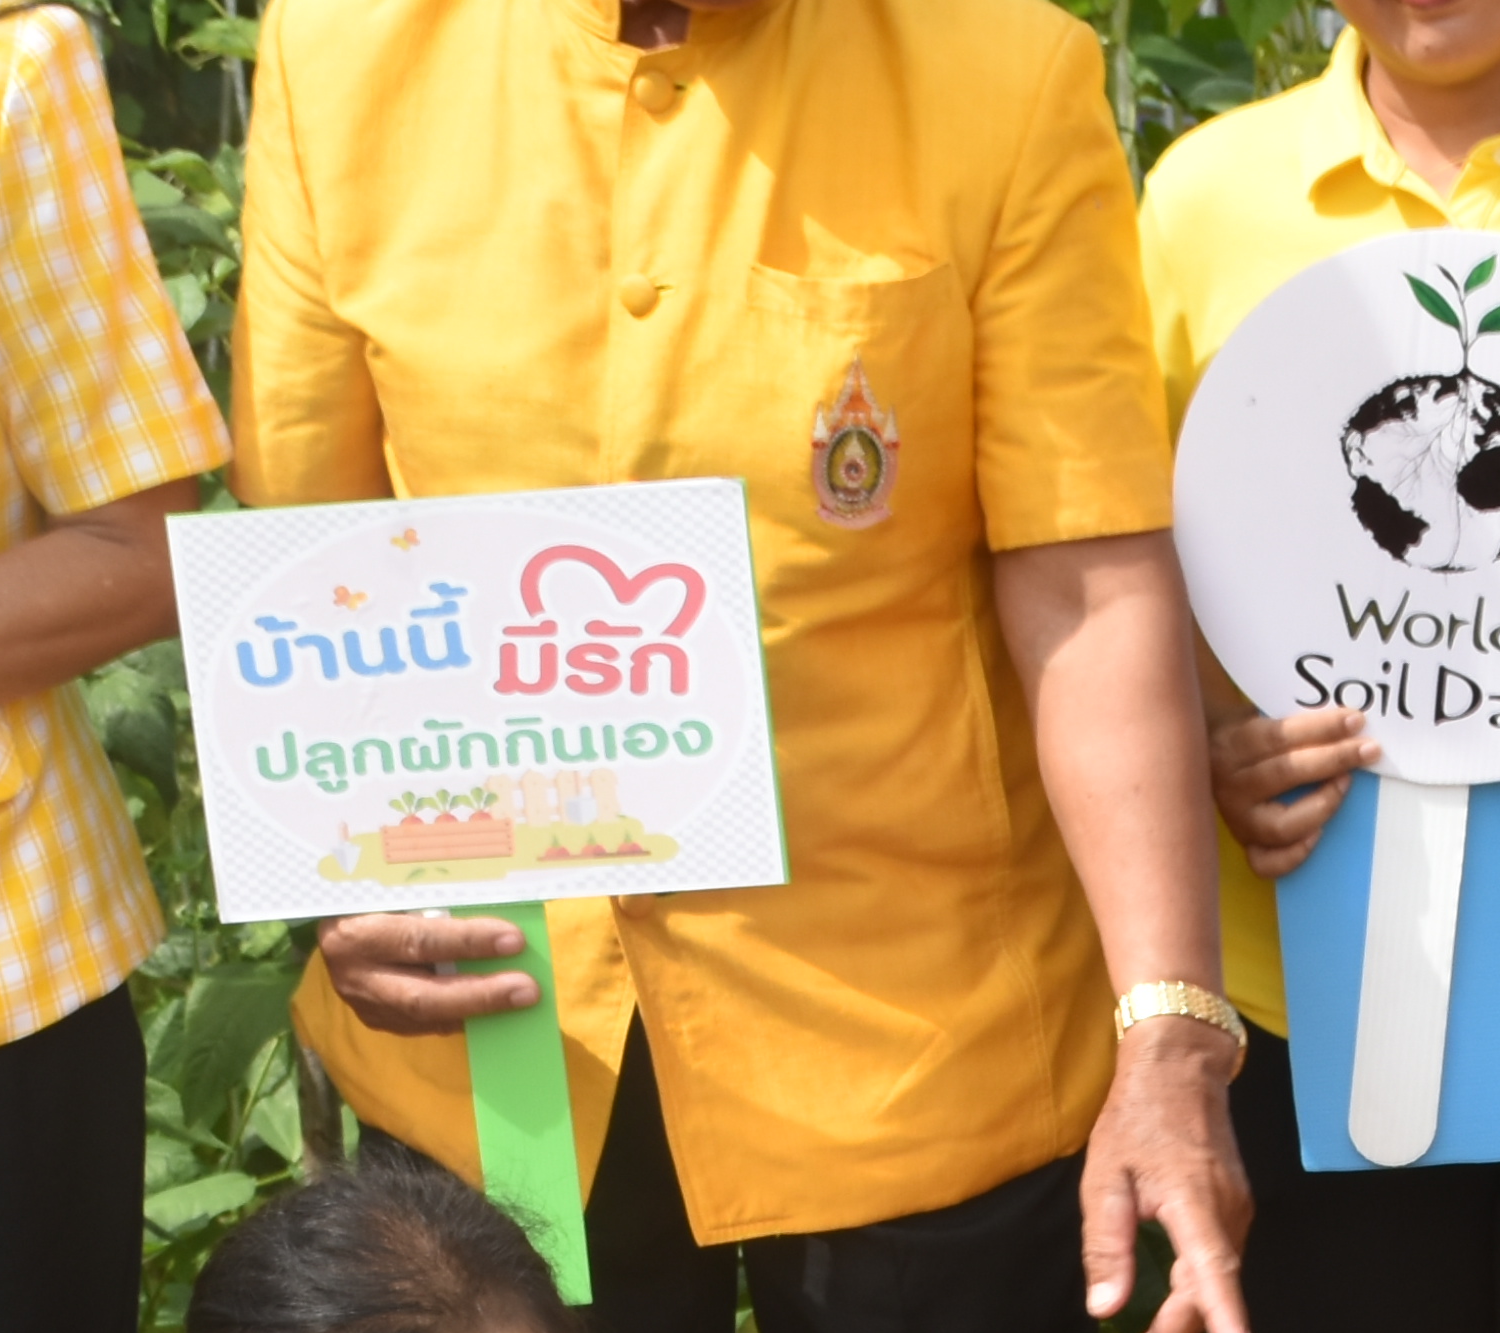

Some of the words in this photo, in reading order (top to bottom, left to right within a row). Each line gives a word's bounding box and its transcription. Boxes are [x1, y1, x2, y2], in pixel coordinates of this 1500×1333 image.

[236, 582, 472, 687] บ้านนี้
[493, 619, 689, 697] มีรัก
[1295, 654, 1414, 720] Soil
[255, 718, 714, 793] ปลูกผักกินเอง
